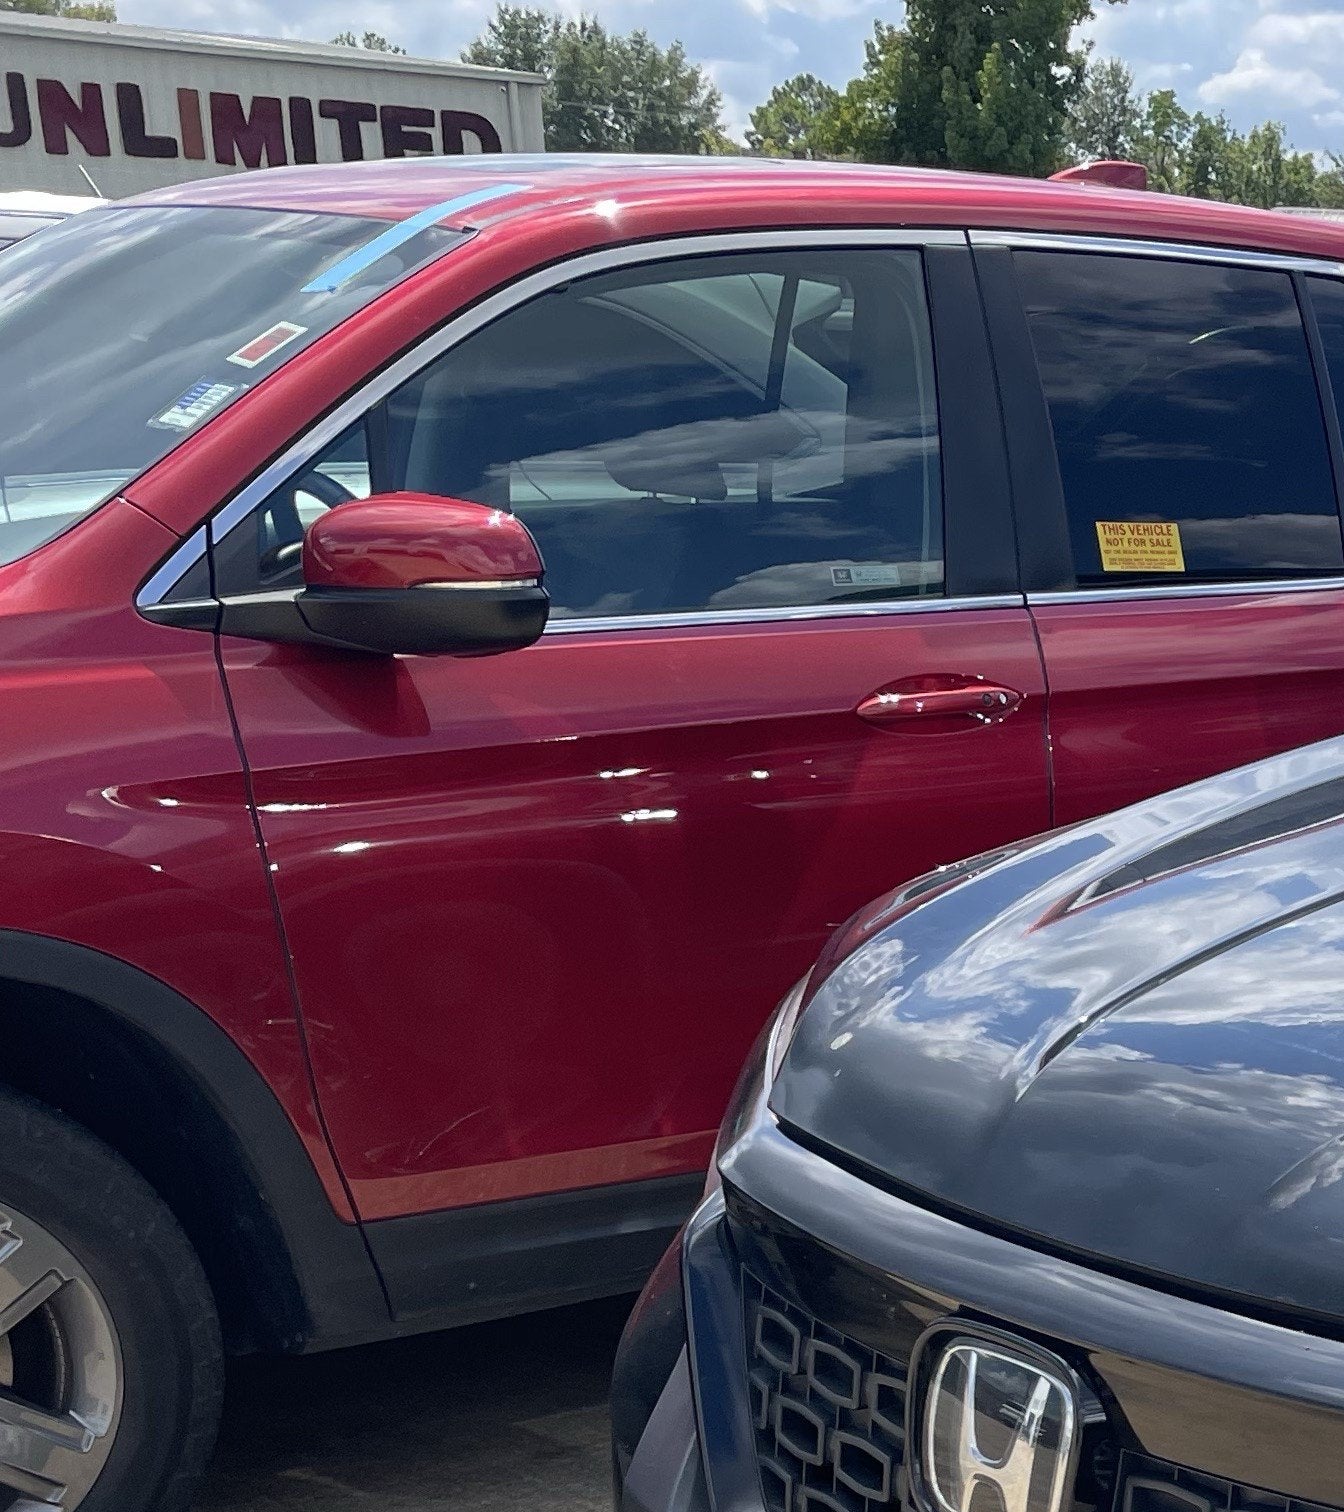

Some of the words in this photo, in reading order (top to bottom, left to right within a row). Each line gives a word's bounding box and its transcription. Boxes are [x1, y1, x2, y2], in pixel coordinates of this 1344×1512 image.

[1101, 524, 1126, 536] THIS
[1127, 524, 1174, 537] VEHICLE
[1105, 538, 1125, 547] NOT
[1128, 538, 1147, 548] FOR
[1150, 538, 1172, 548] SALE
